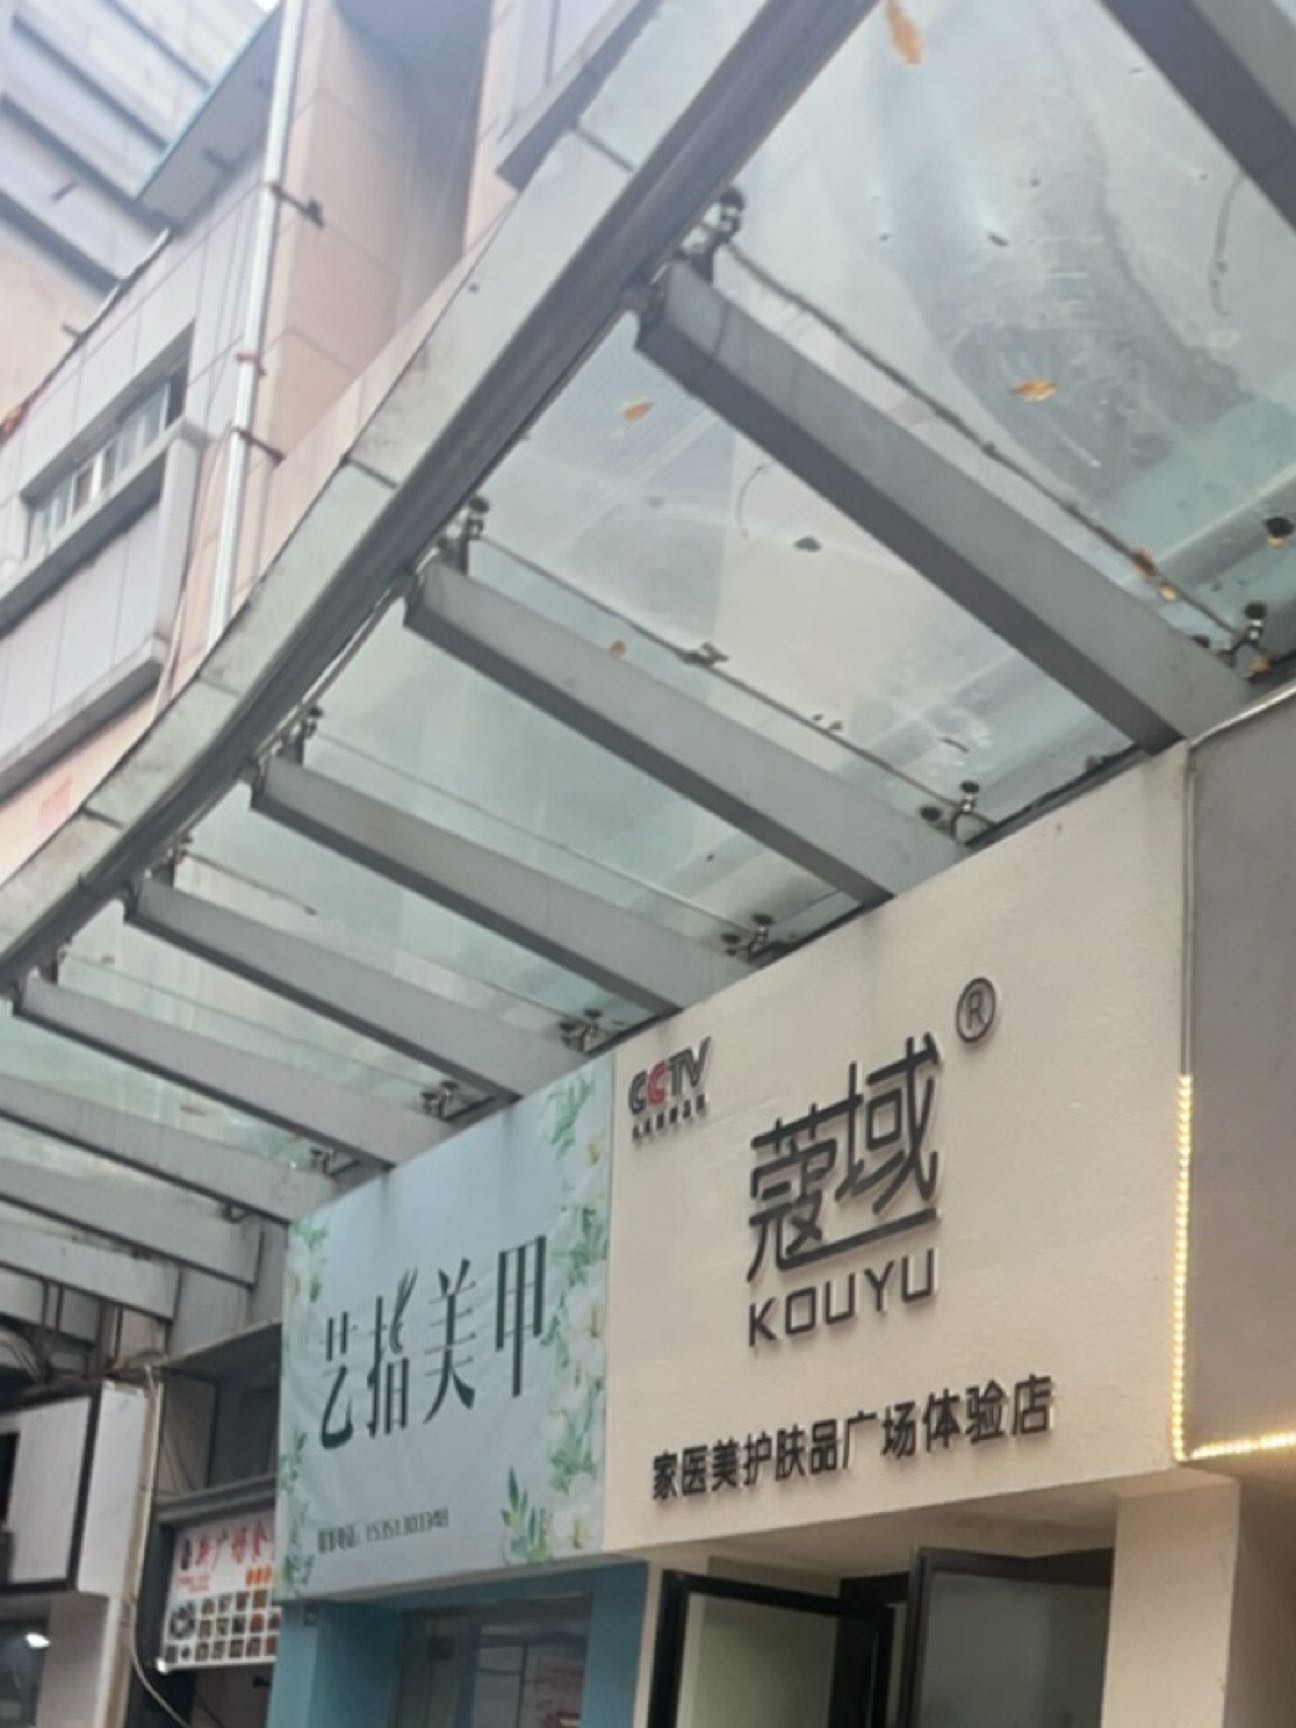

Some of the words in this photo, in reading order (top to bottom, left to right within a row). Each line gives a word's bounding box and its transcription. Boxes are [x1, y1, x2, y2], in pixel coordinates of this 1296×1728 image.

[628, 1036, 712, 1115] CCTV
[746, 1033, 942, 1283] 蔻域
[318, 1235, 548, 1451] 艺指美甲
[748, 1248, 937, 1348] KOUYU
[652, 1373, 1054, 1502] 家医美护肤品广场体验店
